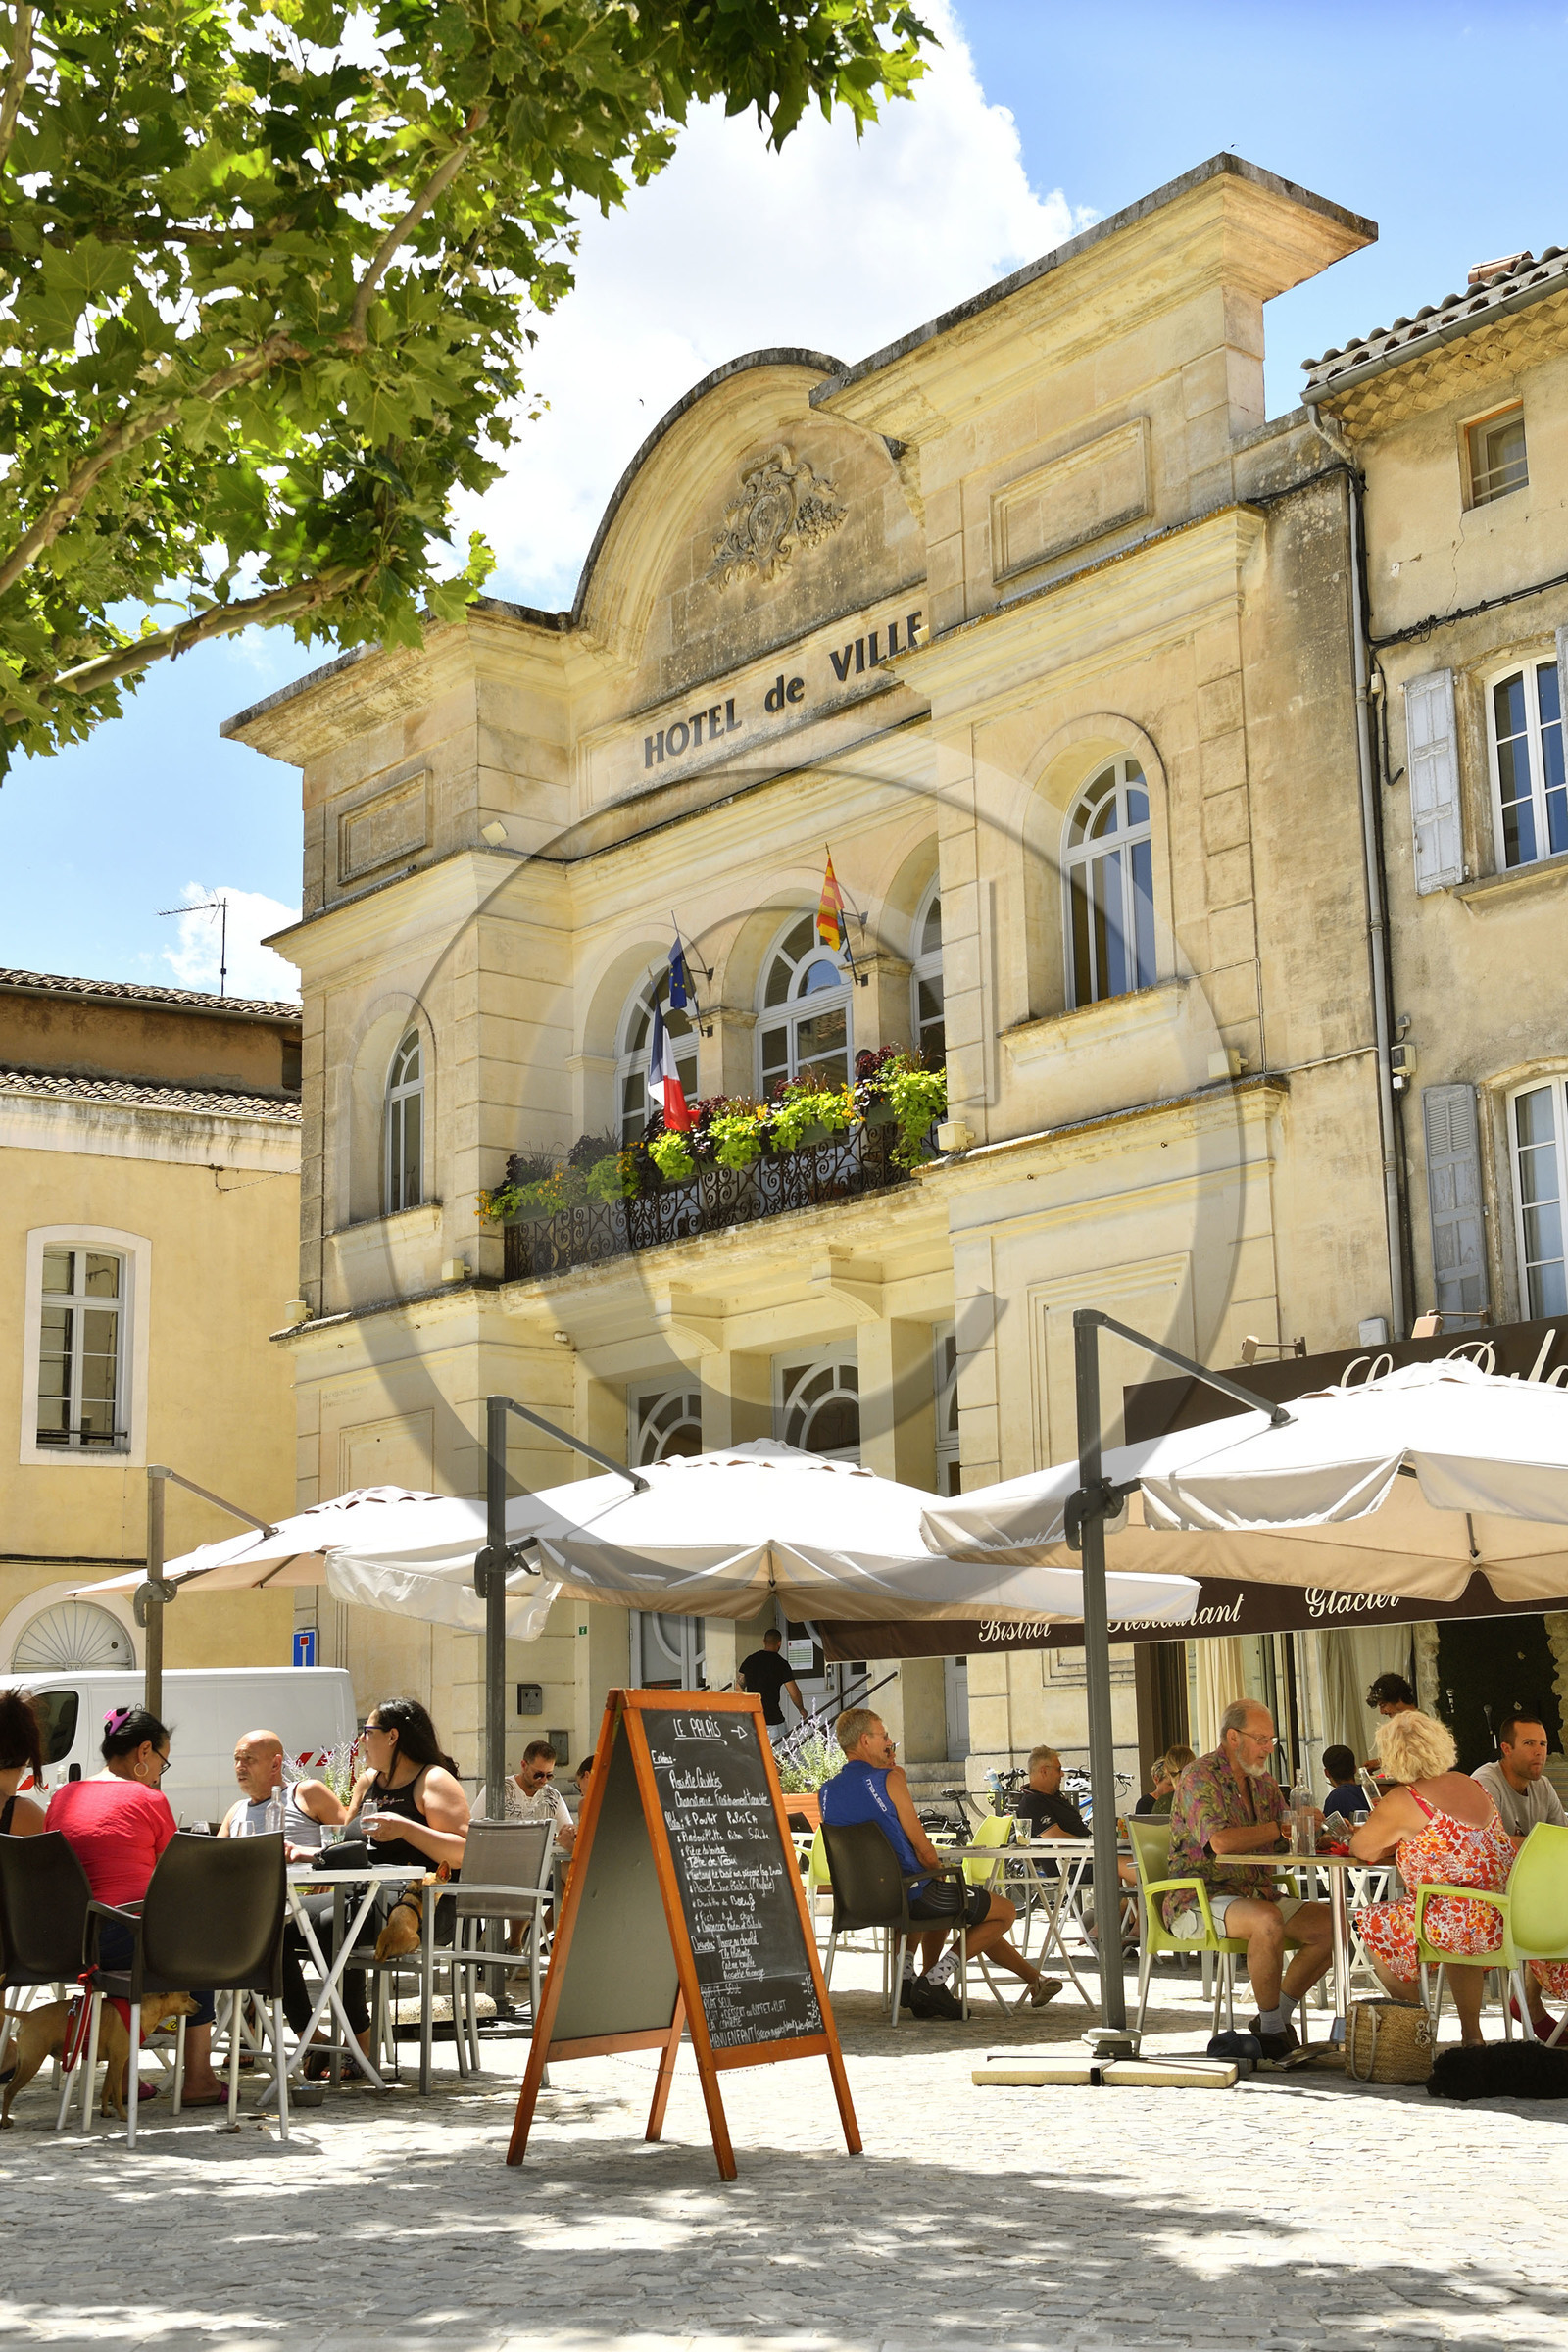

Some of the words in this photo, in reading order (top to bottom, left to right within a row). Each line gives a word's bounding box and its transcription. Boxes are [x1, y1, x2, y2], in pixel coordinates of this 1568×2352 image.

[644, 697, 742, 769] HOTEL
[764, 674, 805, 713] de
[673, 1718, 687, 1738] LE
